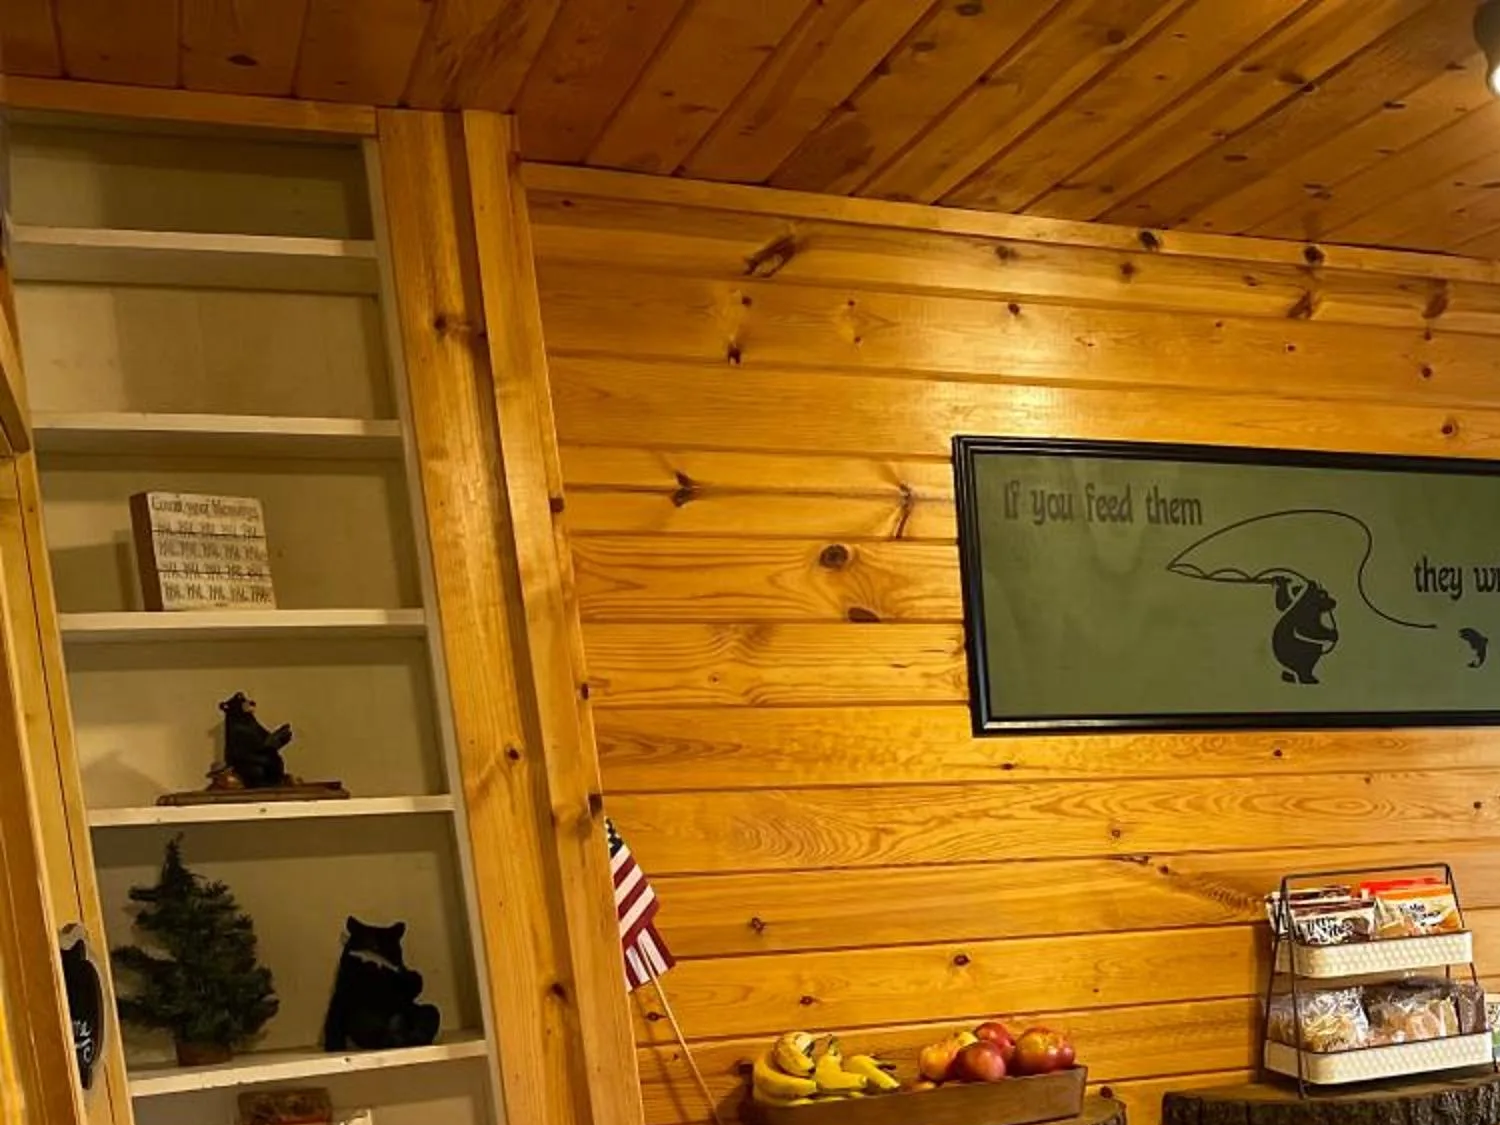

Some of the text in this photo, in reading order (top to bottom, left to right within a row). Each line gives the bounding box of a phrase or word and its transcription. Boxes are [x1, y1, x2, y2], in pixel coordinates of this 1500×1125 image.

[1003, 480, 1203, 525] If you feed them
[1413, 555, 1463, 600] they
